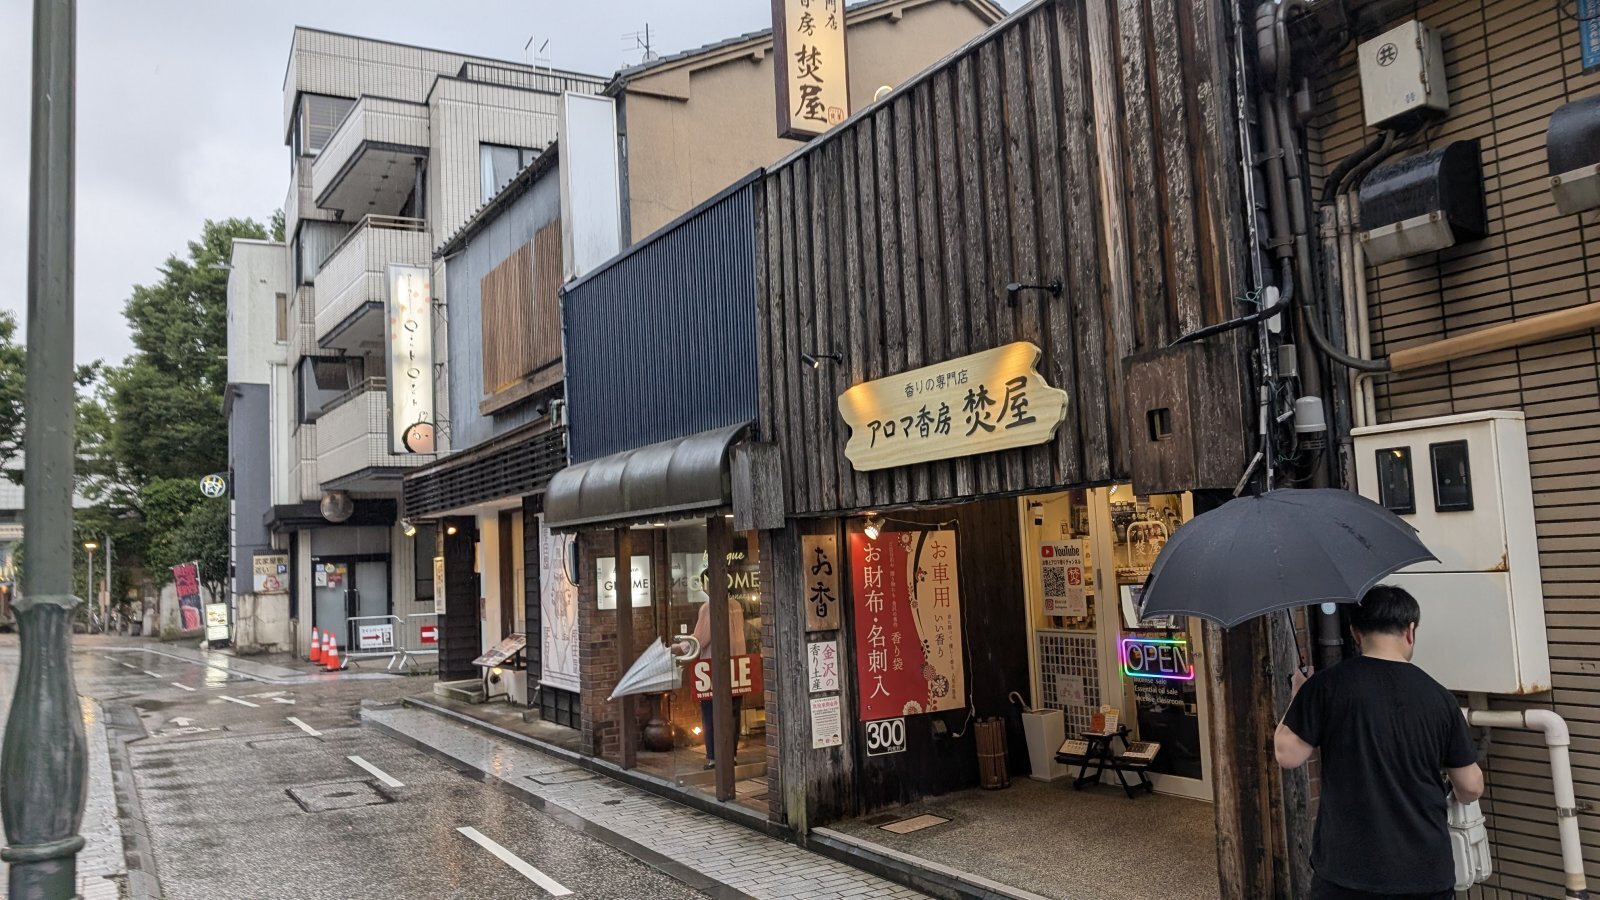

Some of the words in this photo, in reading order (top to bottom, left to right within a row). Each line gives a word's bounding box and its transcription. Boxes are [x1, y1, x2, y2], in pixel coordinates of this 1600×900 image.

[794, 43, 828, 124] 焚屋
[903, 368, 969, 398] 香りの専門店
[866, 401, 952, 448] アロマ香房
[962, 375, 1037, 437] 焚屋
[1054, 545, 1080, 557] YouTube
[604, 579, 649, 591] GME
[810, 546, 836, 618] お香
[930, 540, 951, 609] お車用
[862, 543, 891, 699] お財布・名刺入
[934, 614, 946, 659] いい香り
[809, 643, 823, 691] 香り土産
[821, 643, 838, 687] 金沢の
[890, 631, 904, 671] 香り袋
[1127, 643, 1190, 674] OPEN
[694, 657, 752, 692] SLE
[1166, 688, 1179, 696] sale
[868, 720, 904, 749] 300
